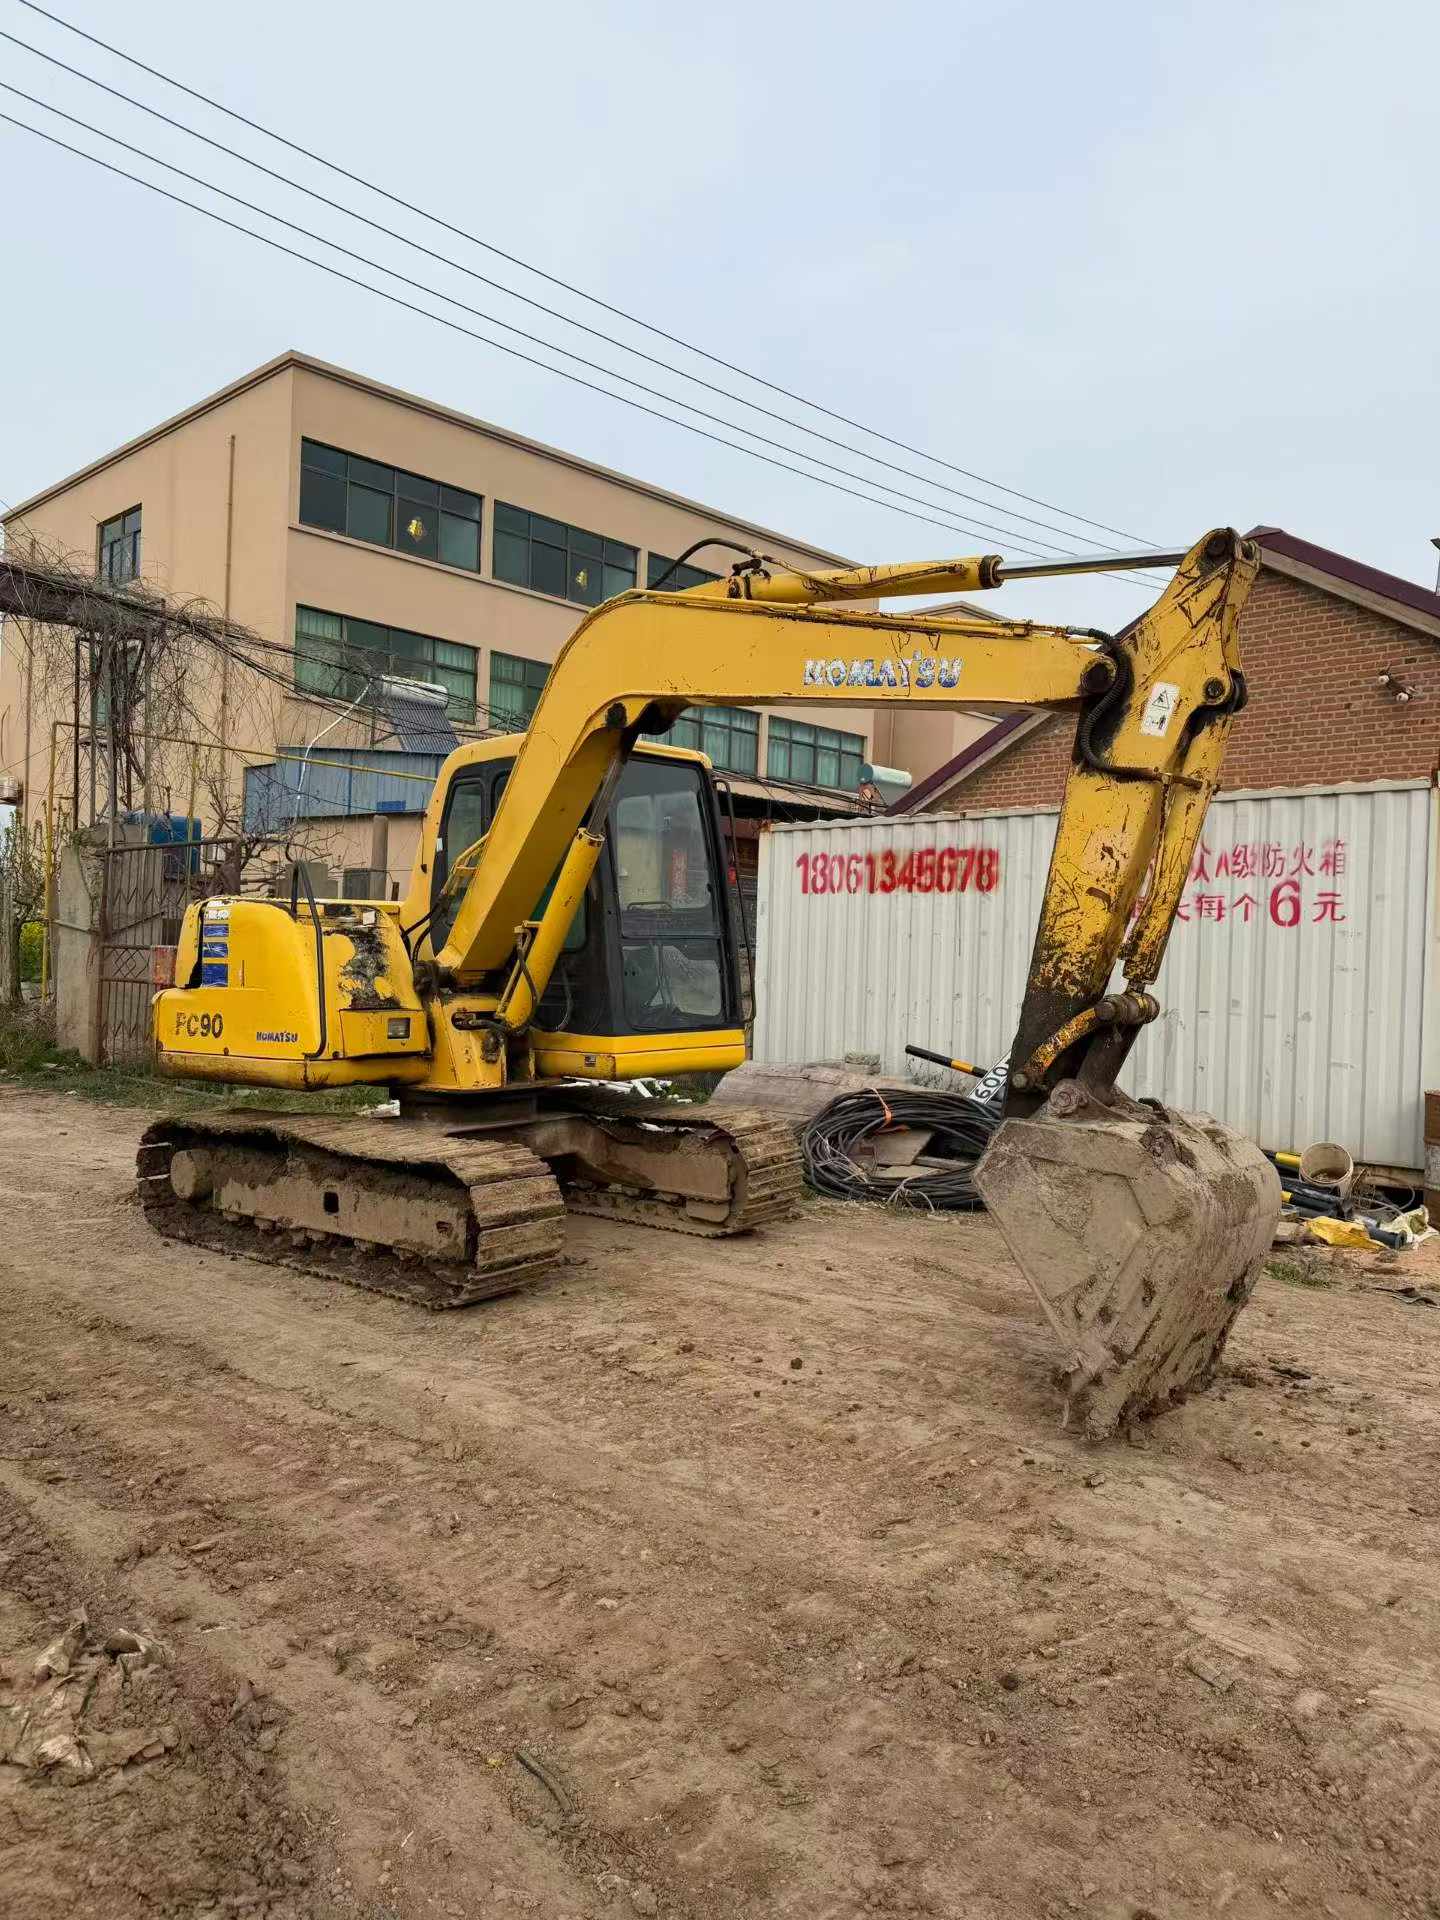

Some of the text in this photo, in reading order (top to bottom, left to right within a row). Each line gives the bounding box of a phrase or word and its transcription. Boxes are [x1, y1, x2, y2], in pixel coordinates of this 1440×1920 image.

[803, 650, 963, 689] KOMATSU
[796, 847, 999, 894] 18061345678
[175, 1011, 223, 1039] PC90
